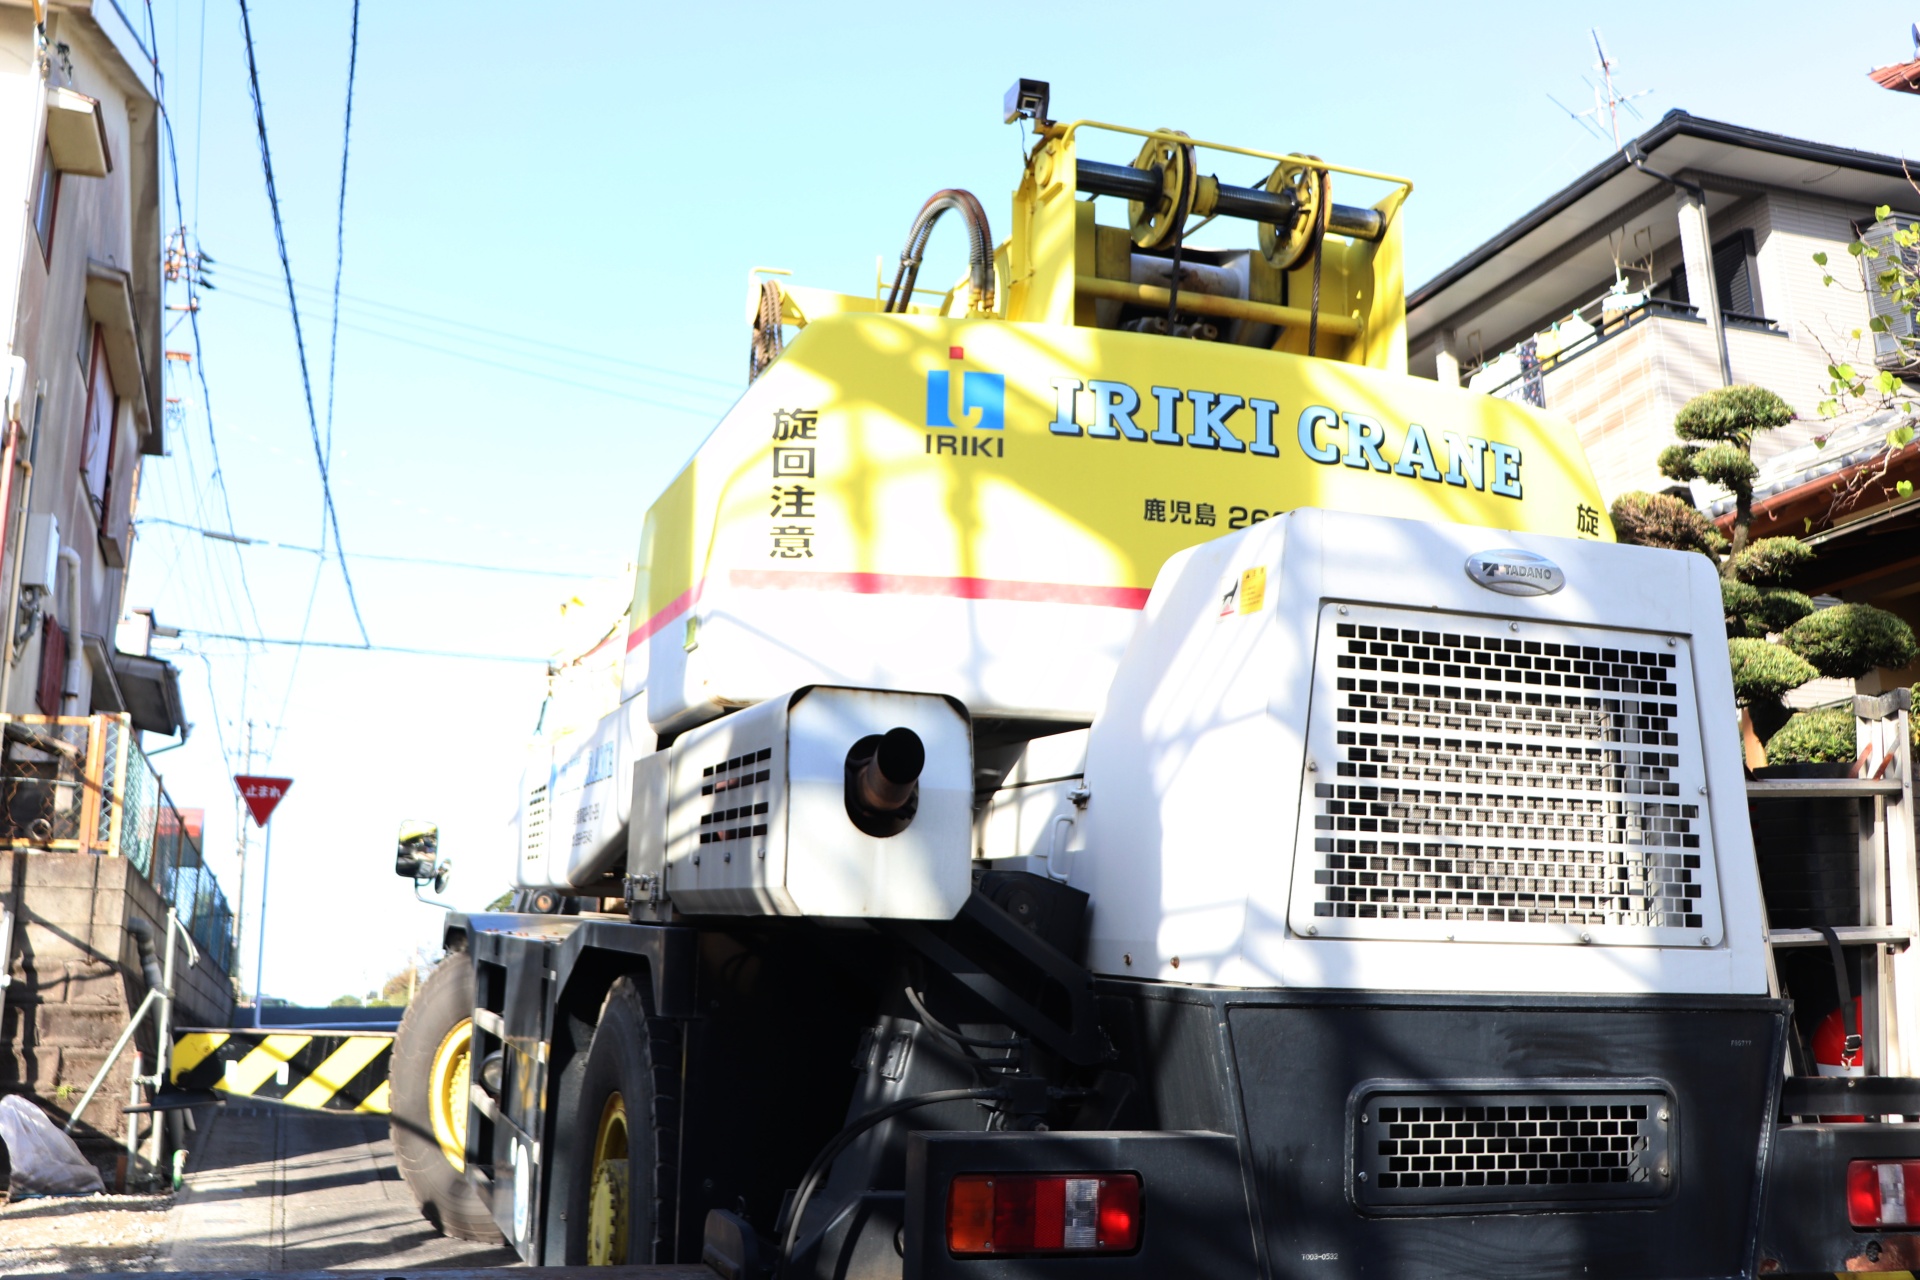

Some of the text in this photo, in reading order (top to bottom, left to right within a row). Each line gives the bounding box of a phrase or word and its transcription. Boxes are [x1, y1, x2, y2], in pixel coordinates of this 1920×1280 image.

[926, 434, 1004, 458] IRIKI
[1049, 378, 1524, 500] IRIKI CRANE
[770, 408, 818, 558] 旋回注意
[1144, 498, 1286, 529] 鹿児島 26
[1577, 503, 1599, 540] 旋
[1504, 564, 1552, 580] TADANO
[245, 784, 282, 798] 止まれ
